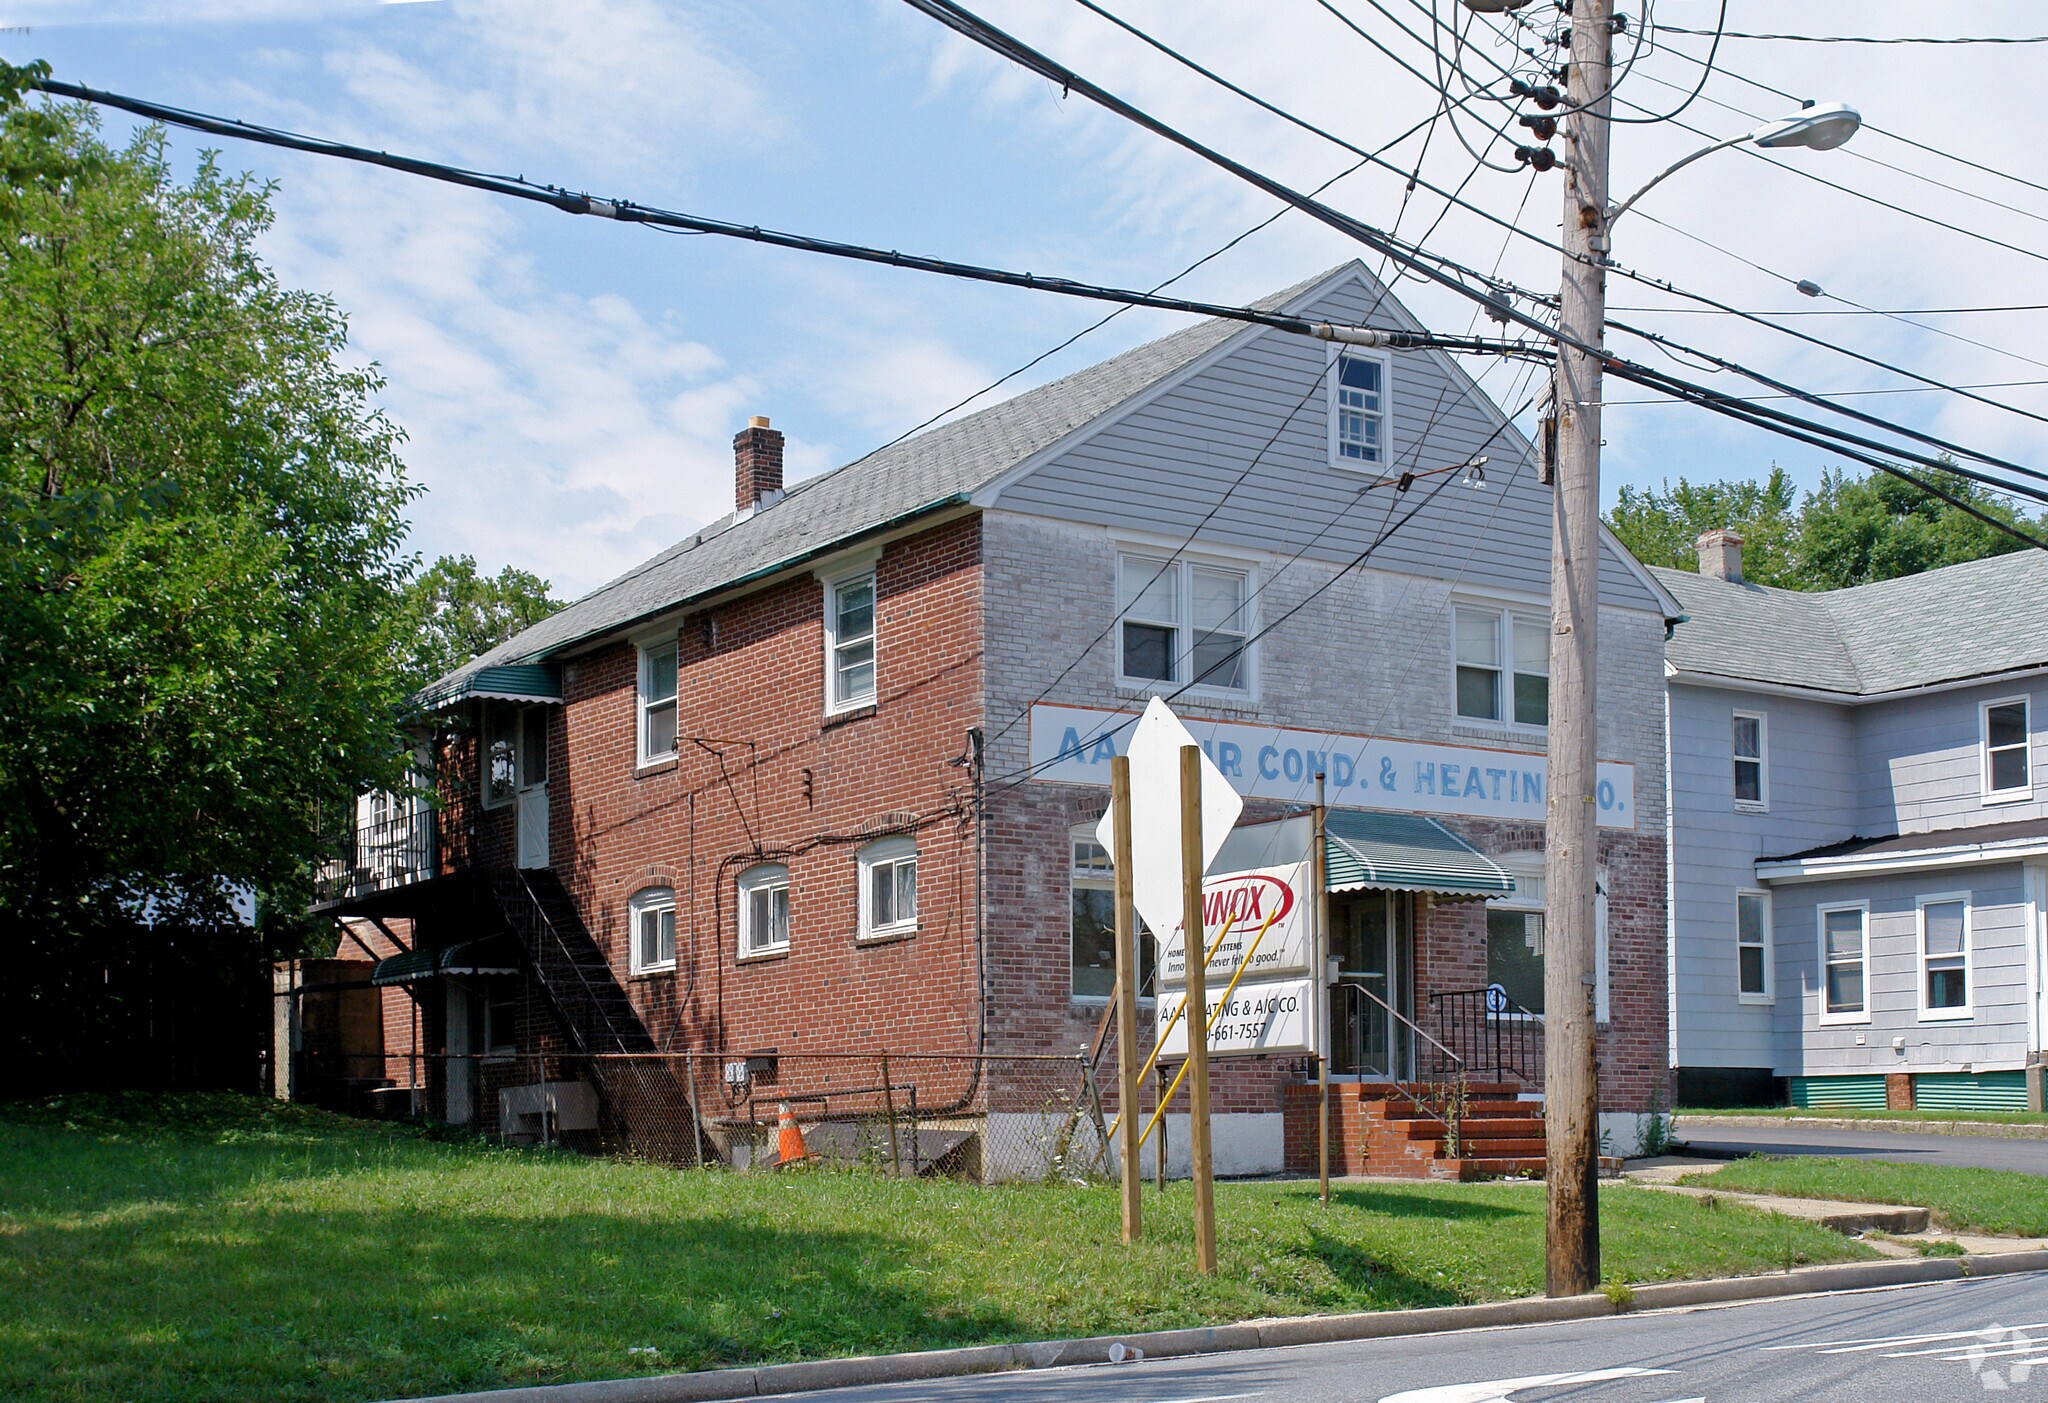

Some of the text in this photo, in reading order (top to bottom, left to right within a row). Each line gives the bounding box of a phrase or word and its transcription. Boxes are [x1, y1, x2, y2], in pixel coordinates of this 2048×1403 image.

[1058, 726, 1625, 811] AA IR COND. & HEATIN O.
[1201, 884, 1267, 927] NNOX
[1167, 949, 1185, 958] HOME
[1209, 957, 1230, 968] never
[1231, 953, 1244, 966] felt
[1160, 996, 1299, 1022] AAA ATING & A/C CO.
[1206, 1022, 1267, 1041] -661-7557
